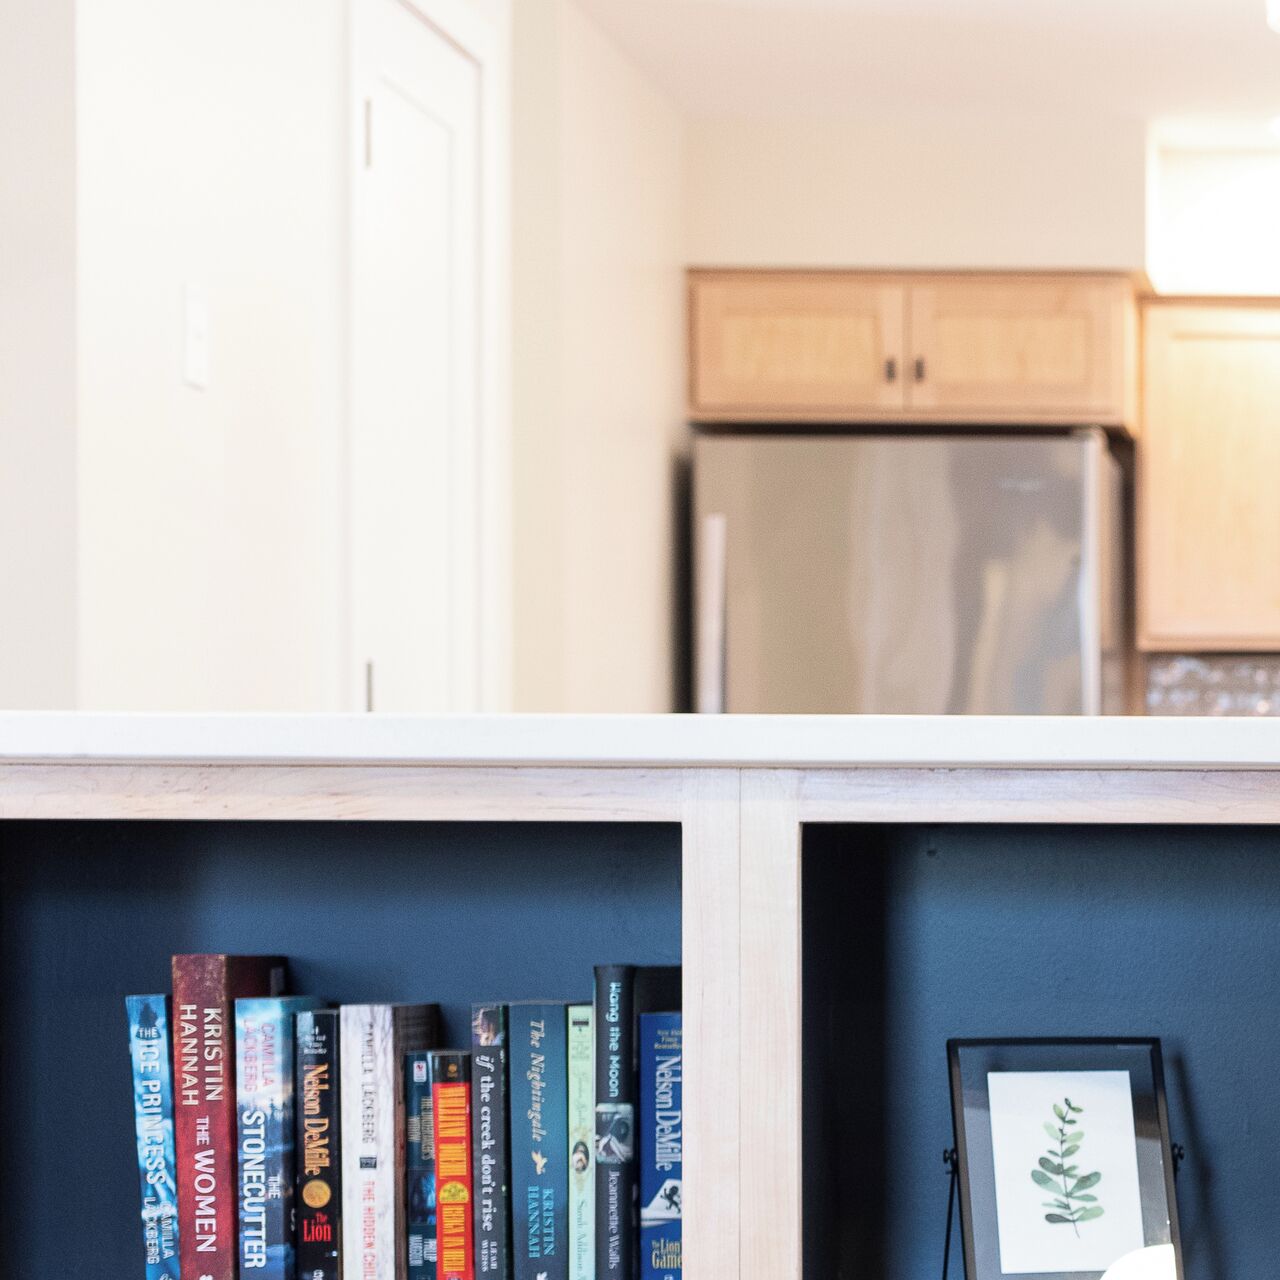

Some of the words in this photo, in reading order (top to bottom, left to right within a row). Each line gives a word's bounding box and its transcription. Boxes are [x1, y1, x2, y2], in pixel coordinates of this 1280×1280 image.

[606, 982, 621, 1022] Hang
[138, 1027, 158, 1038] THE
[530, 1019, 545, 1048] The
[609, 1027, 621, 1051] the
[139, 1040, 160, 1073] ICE
[180, 1004, 199, 1106] HANNAH
[203, 1008, 224, 1101] KRISTIN
[476, 1055, 494, 1072] if
[303, 1063, 329, 1115] Nelson
[480, 1076, 495, 1103] the
[608, 1055, 621, 1098] Moon
[656, 1055, 682, 1108] Nelson
[527, 1054, 546, 1142] Nightingale
[142, 1080, 167, 1185] PRINCESS
[196, 1115, 210, 1146] THE
[303, 1117, 330, 1176] DeMille
[480, 1107, 496, 1149] creek
[656, 1111, 682, 1172] DeMille
[242, 1110, 267, 1268] STONECUTTER
[267, 1174, 282, 1199] THE
[481, 1154, 496, 1194] don't
[194, 1149, 217, 1252] WOMEN
[482, 1199, 497, 1231] rise
[608, 1170, 621, 1232] Jeannette
[303, 1218, 332, 1242] Lion
[528, 1186, 541, 1258] HANNAH
[543, 1188, 555, 1256] KRISTIN
[608, 1234, 621, 1270] Walls
